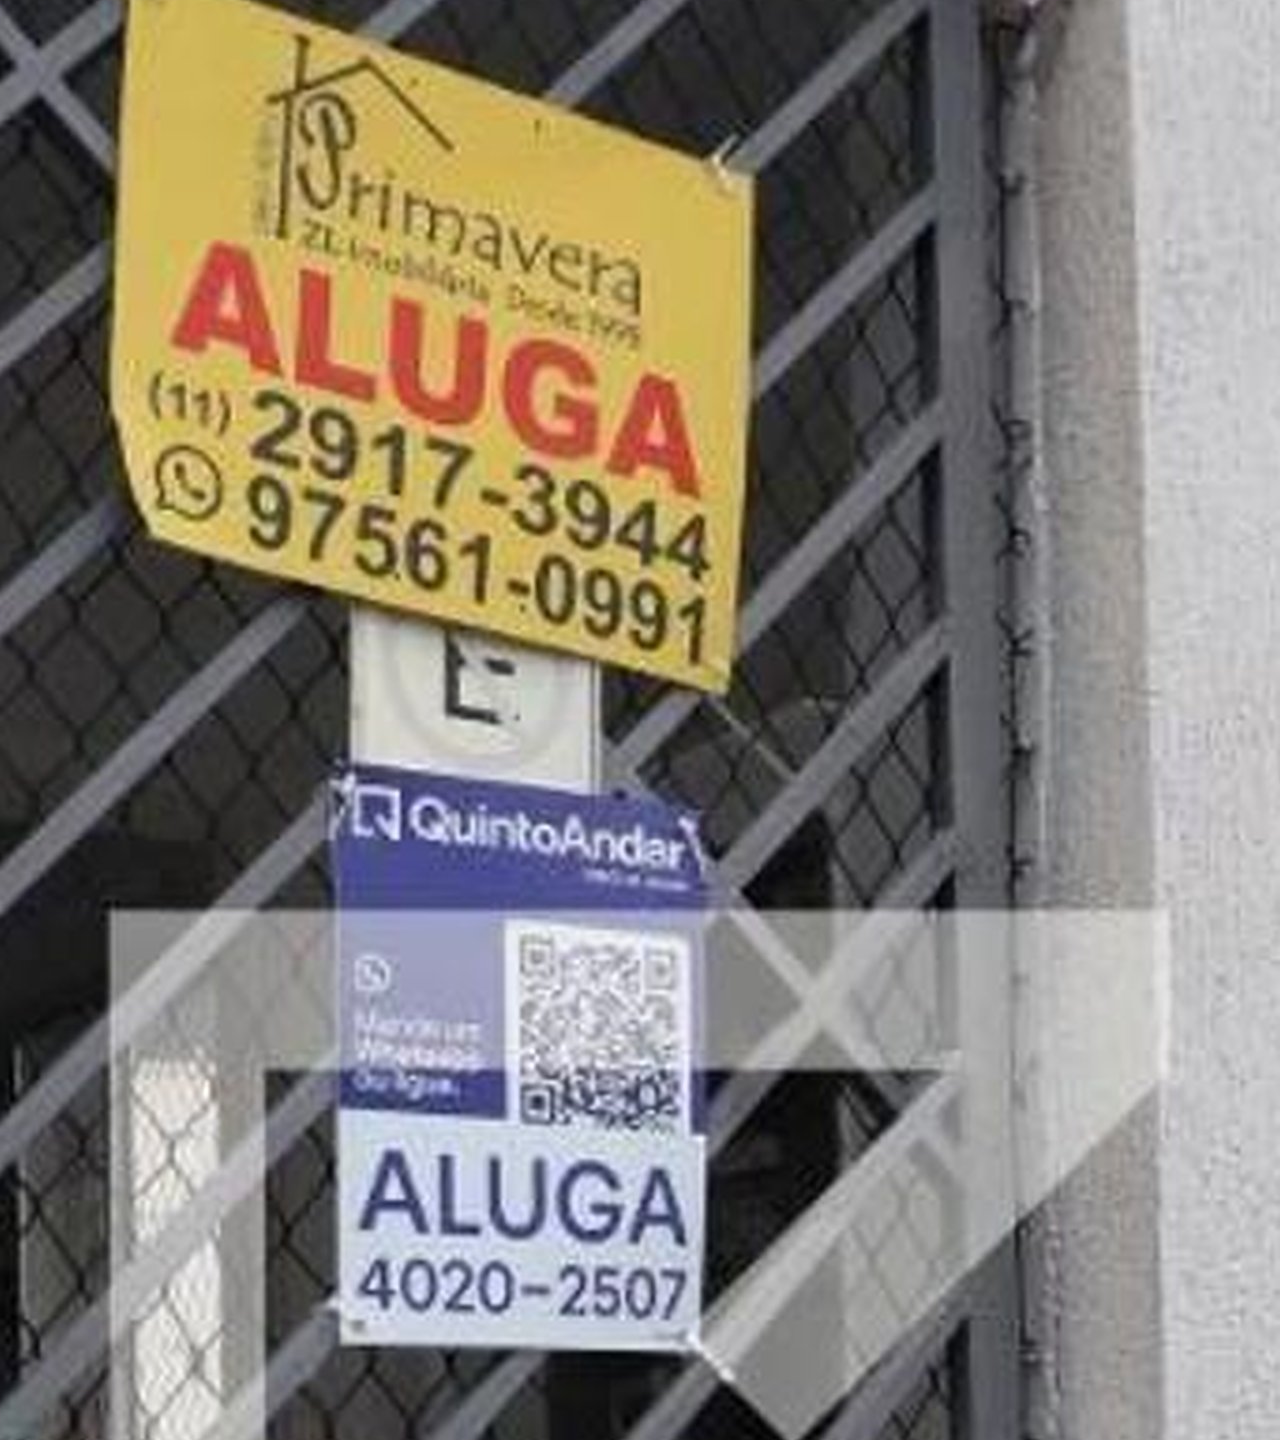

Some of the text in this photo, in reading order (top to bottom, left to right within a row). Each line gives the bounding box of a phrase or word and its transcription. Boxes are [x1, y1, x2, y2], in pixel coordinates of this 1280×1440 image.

[296, 91, 642, 316] Primavera
[171, 240, 700, 501] ALUGA
[148, 372, 714, 583] (11) 2917-3944
[246, 474, 708, 664] 97561-0991
[410, 796, 686, 871] QuintoAndar
[357, 1258, 688, 1321] 4020-2507
[358, 1148, 687, 1246] ALUGA
